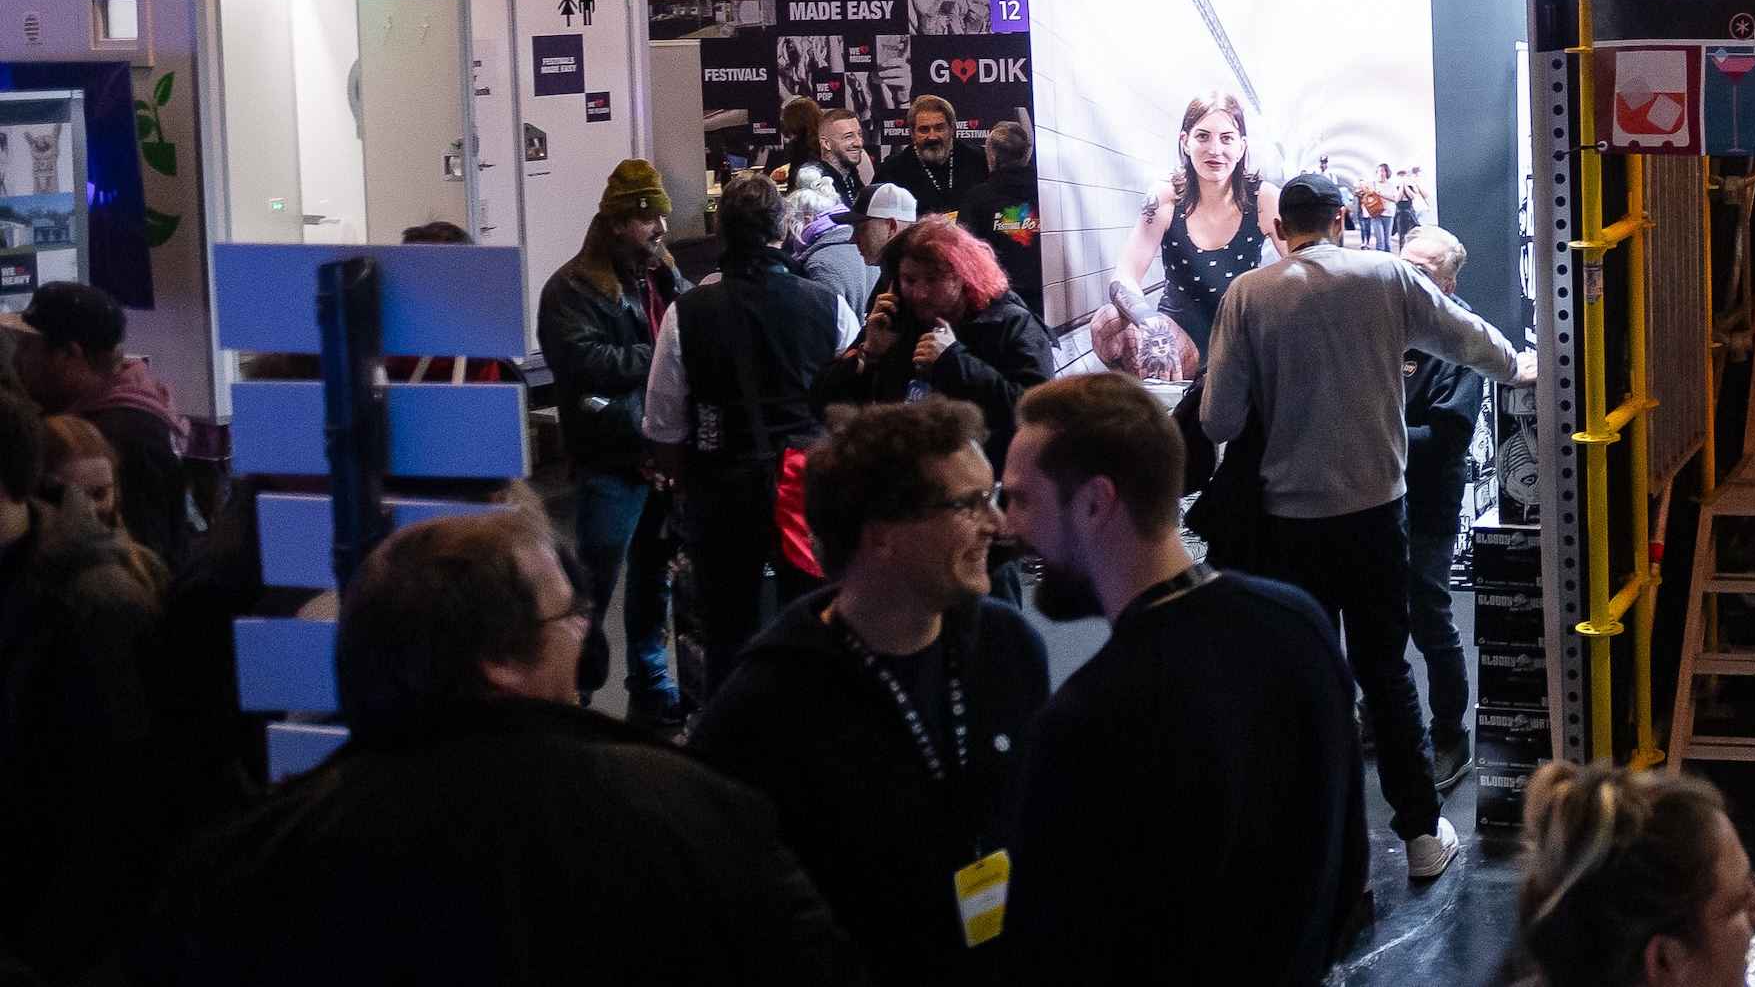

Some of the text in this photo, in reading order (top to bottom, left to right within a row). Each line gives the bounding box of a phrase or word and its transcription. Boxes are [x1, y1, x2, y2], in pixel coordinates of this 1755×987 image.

[789, 0, 894, 21] MADE EASY
[999, 0, 1021, 21] 12
[704, 68, 768, 82] FESTIVALS
